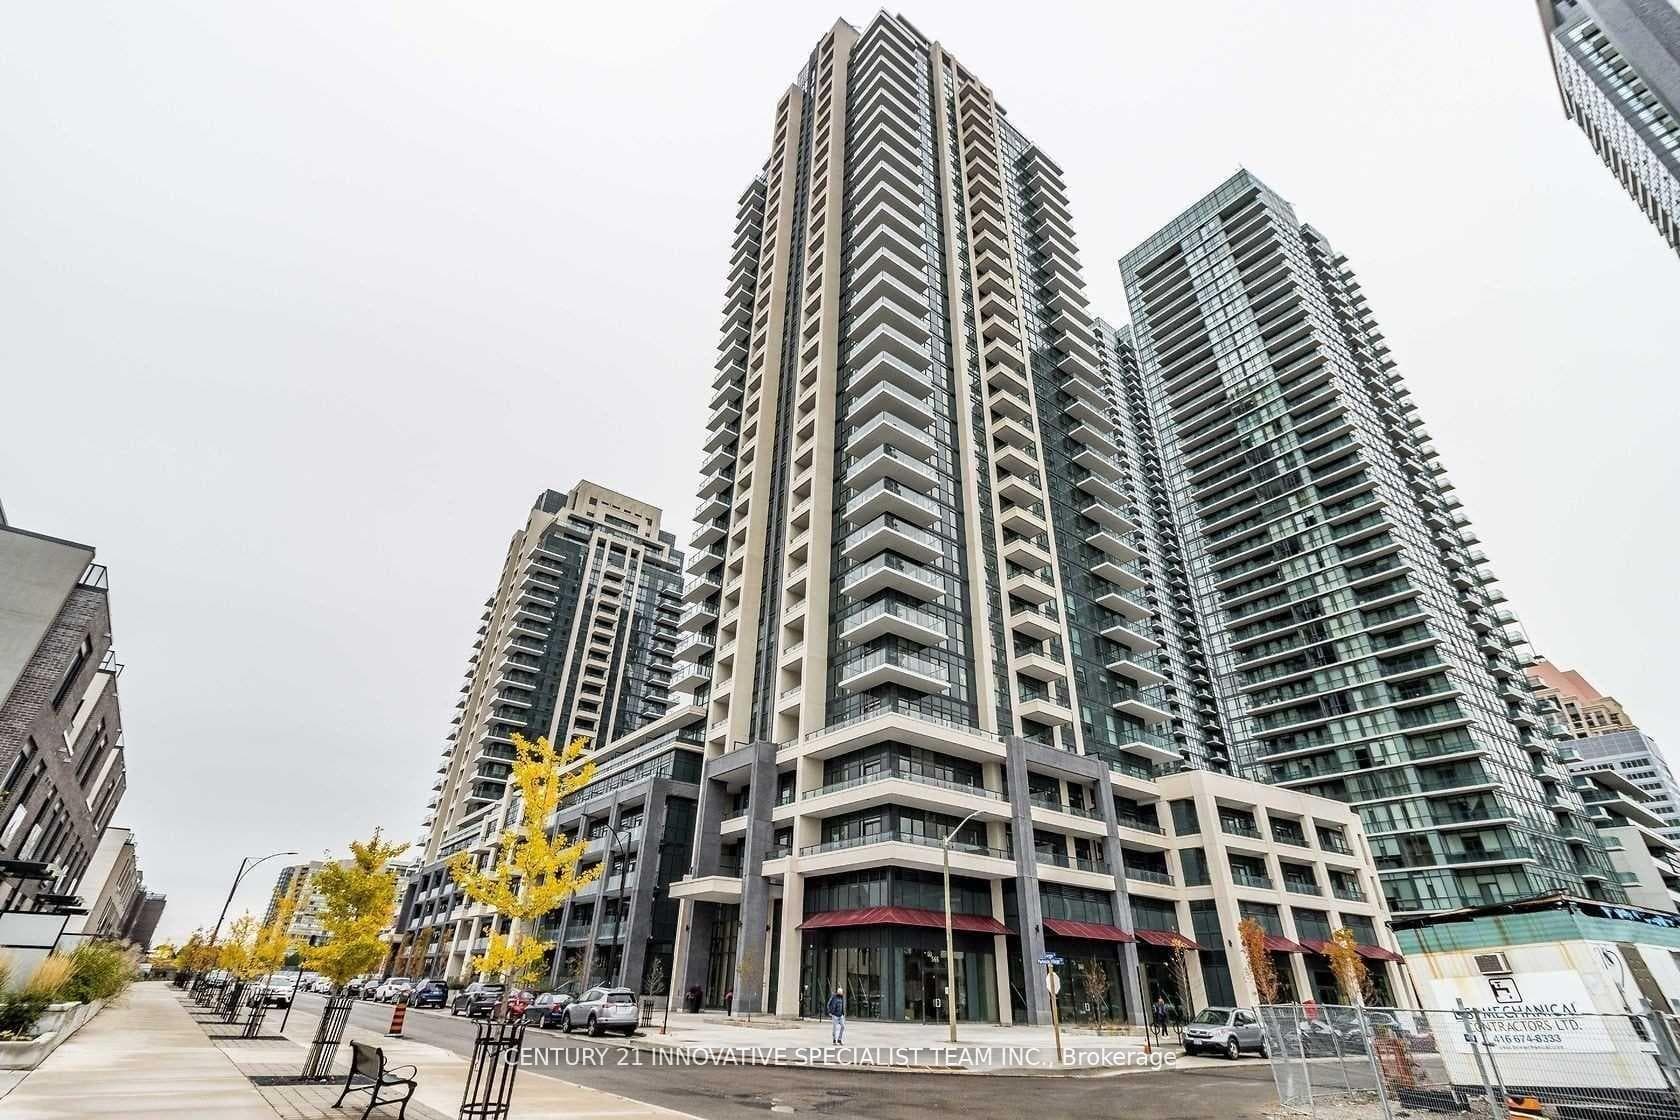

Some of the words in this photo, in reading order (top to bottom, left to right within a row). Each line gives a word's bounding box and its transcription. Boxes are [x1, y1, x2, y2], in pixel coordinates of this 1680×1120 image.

[1466, 1020, 1552, 1033] ONTRACTORS
[1555, 1020, 1582, 1031] LTD.
[1494, 1034, 1513, 1044] 416
[1513, 1033, 1562, 1043] 674-8333
